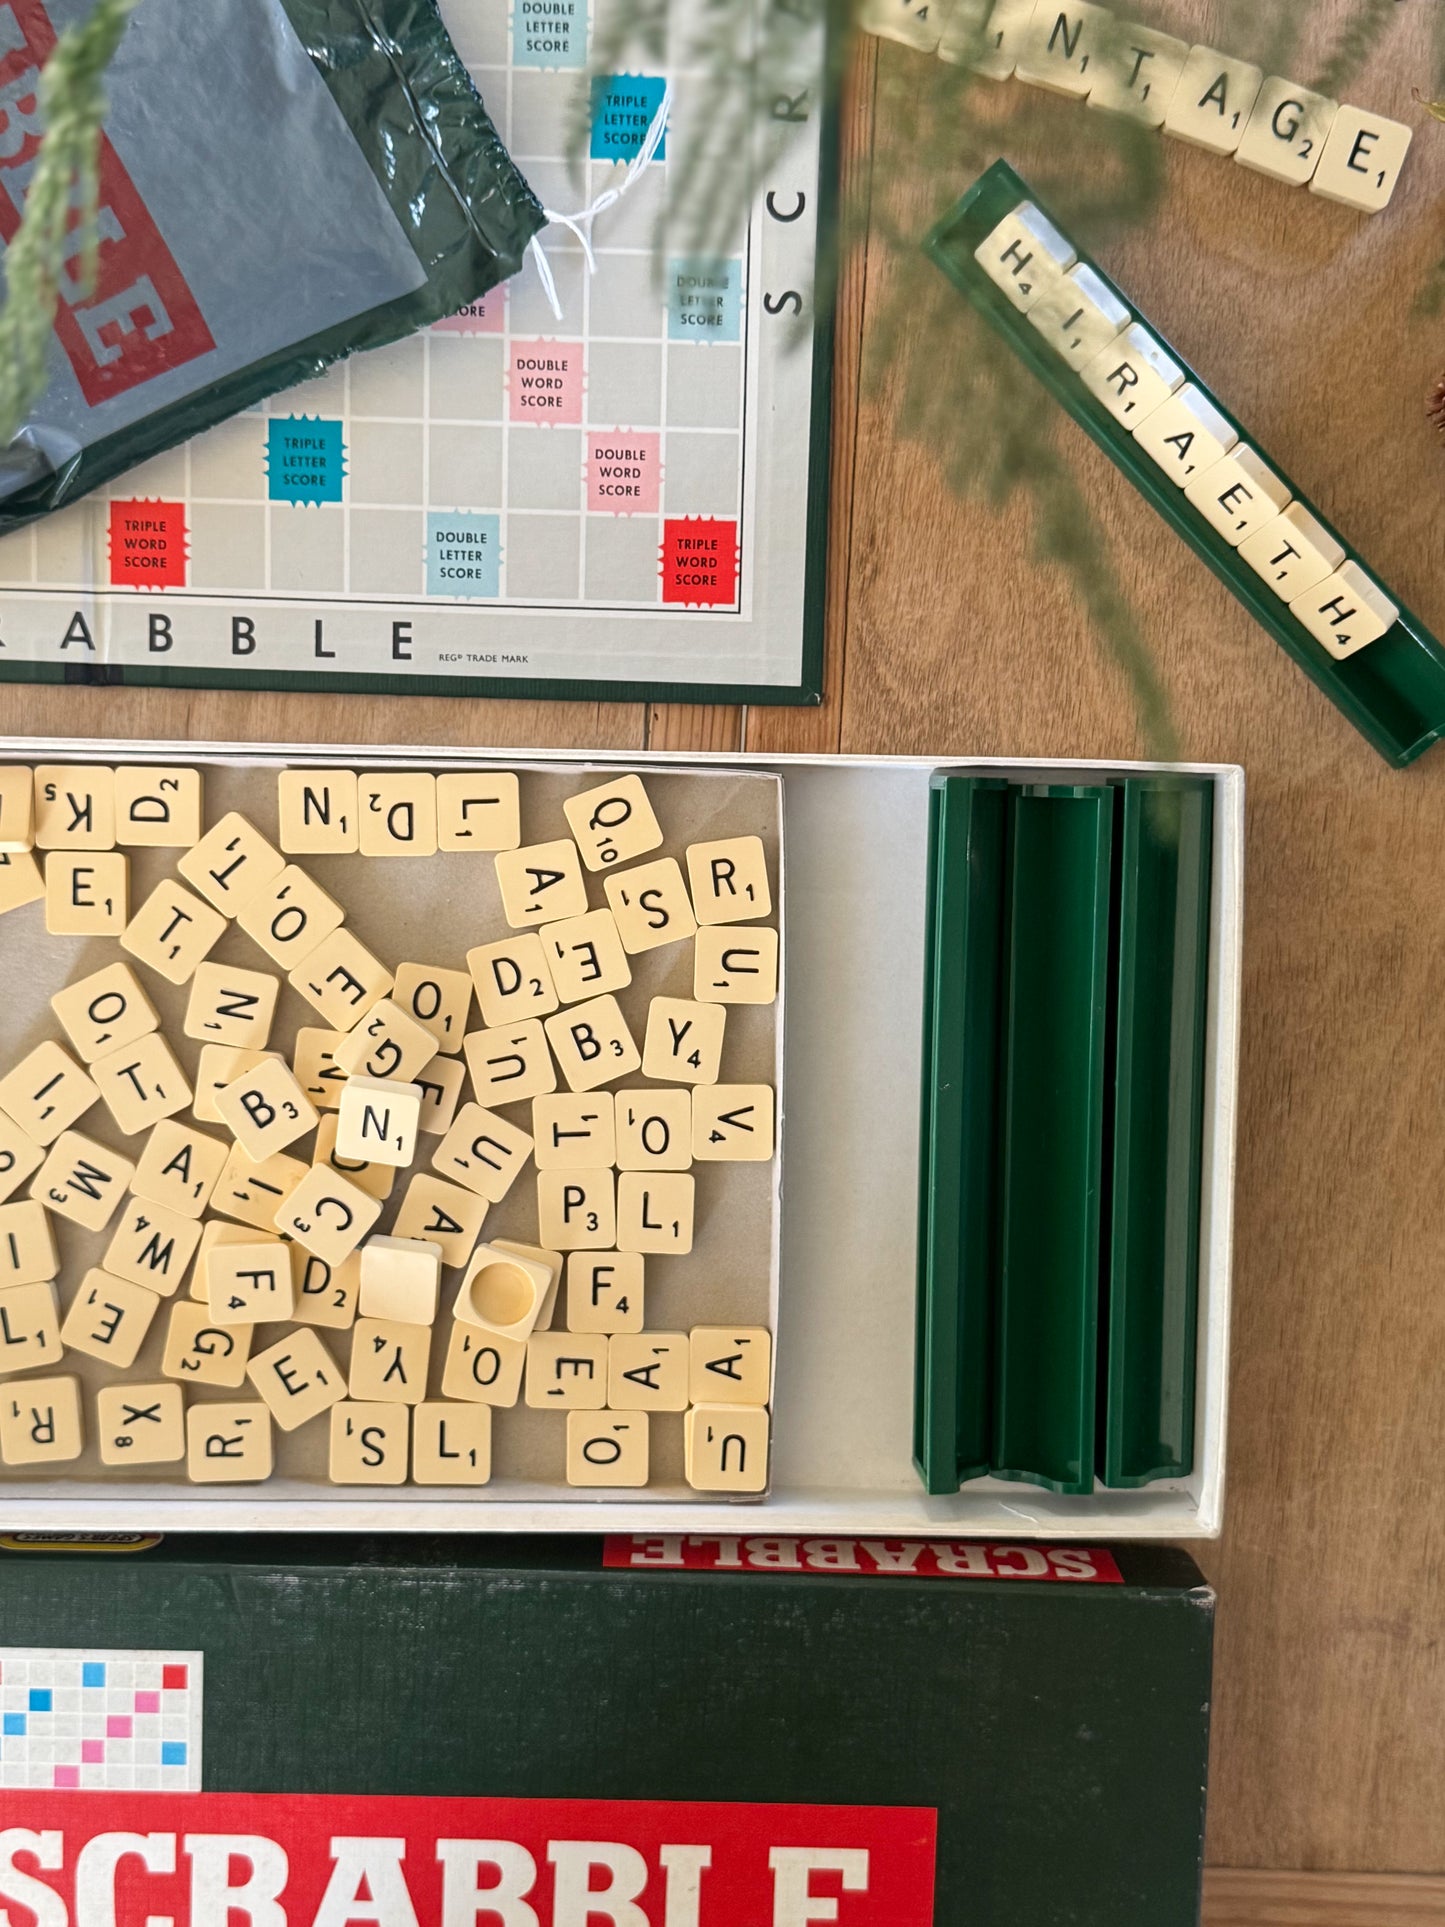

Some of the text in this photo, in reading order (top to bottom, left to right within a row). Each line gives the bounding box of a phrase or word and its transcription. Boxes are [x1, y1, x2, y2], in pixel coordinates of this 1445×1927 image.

[522, 2, 575, 15] DOUBLE
[526, 22, 569, 33] LETTER
[527, 40, 569, 52] SCORE
[606, 95, 647, 108] TRIPLE
[605, 114, 647, 126] LETTER
[677, 276, 730, 290] DOUBE
[680, 295, 724, 308] LETR
[454, 306, 485, 317] ORE
[681, 314, 723, 326] SCORE
[517, 359, 568, 371] DOUBLE
[521, 378, 563, 390] WORD
[521, 396, 563, 408] SCORE
[284, 437, 326, 450] TRIPLE
[595, 449, 646, 461] DOUBLE
[283, 456, 326, 468] LETTER
[599, 467, 641, 479] WORD
[283, 474, 326, 486] SCORE
[599, 485, 640, 497] SCORE
[125, 520, 166, 532] TRIPLE
[436, 532, 487, 544] DOUBLE
[124, 539, 167, 550] WORD
[677, 539, 718, 551] TRIPLE
[439, 550, 482, 561] LETTER
[124, 557, 167, 568] SCORE
[676, 556, 717, 568] WORD
[440, 568, 482, 579] SCORE
[675, 574, 717, 586] SCORE
[466, 653, 497, 664] TRADE
[501, 654, 529, 664] MARK
[630, 1533, 1097, 1578] SCRABBLE
